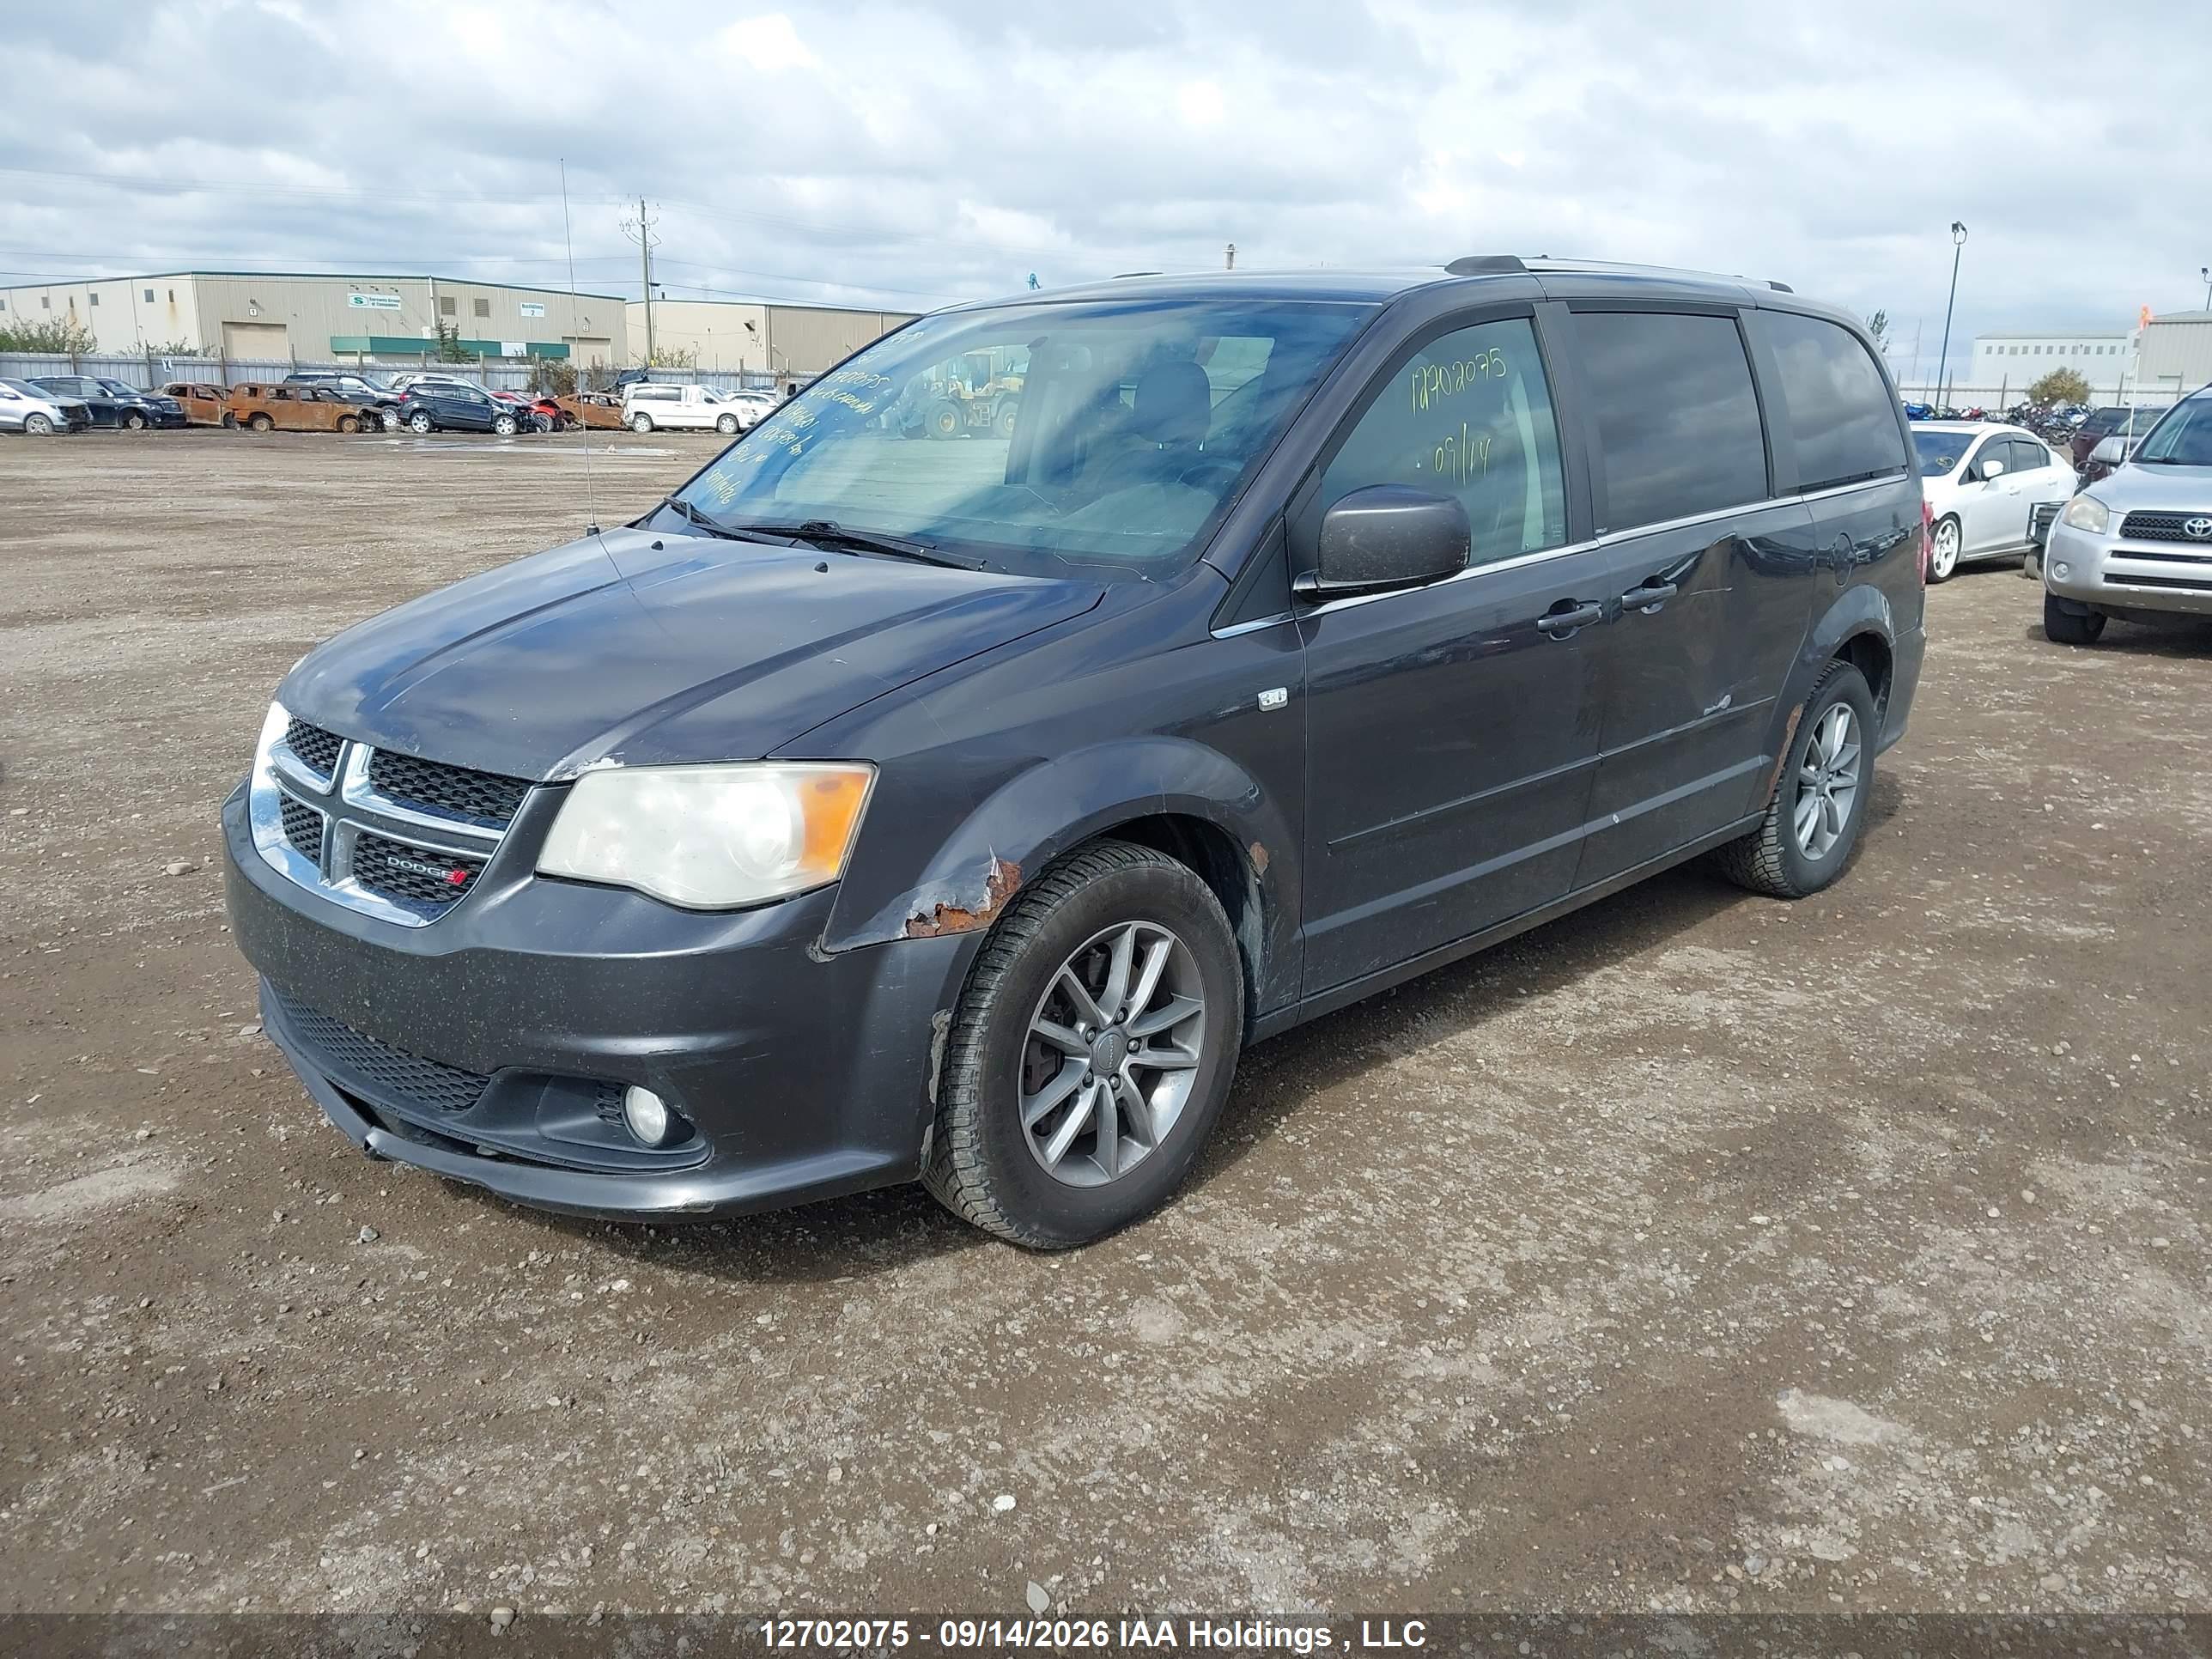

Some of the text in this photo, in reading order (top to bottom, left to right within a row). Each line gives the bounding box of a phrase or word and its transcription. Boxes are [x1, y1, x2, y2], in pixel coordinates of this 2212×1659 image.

[1411, 347, 1506, 418] 12702075
[1435, 423, 1491, 486] 09/14
[388, 857, 455, 881] DODGE
